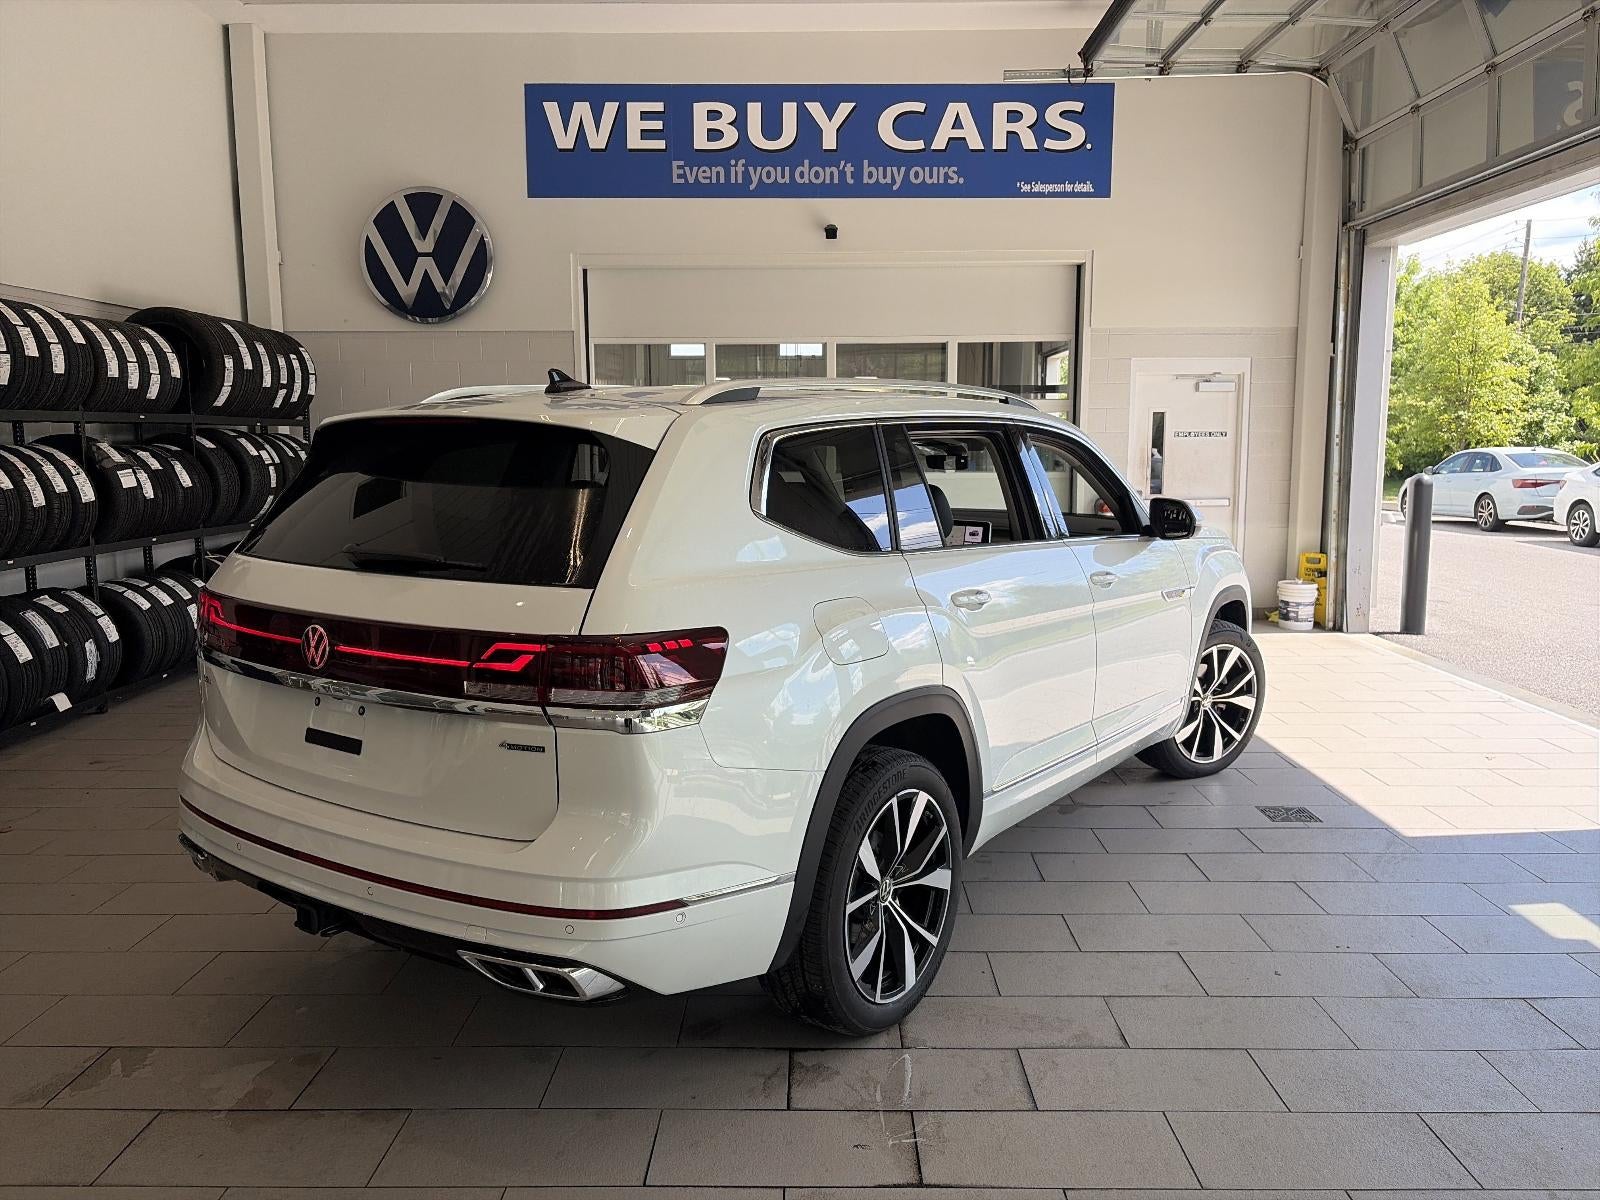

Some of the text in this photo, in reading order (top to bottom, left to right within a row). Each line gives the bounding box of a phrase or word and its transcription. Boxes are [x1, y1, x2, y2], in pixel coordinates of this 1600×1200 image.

[542, 100, 1092, 150] WE BUY CARS.
[671, 158, 965, 191] Even if you don’t buy ours.
[1031, 180, 1065, 195] Salesperson
[1065, 180, 1073, 192] for
[1073, 180, 1095, 192] details.
